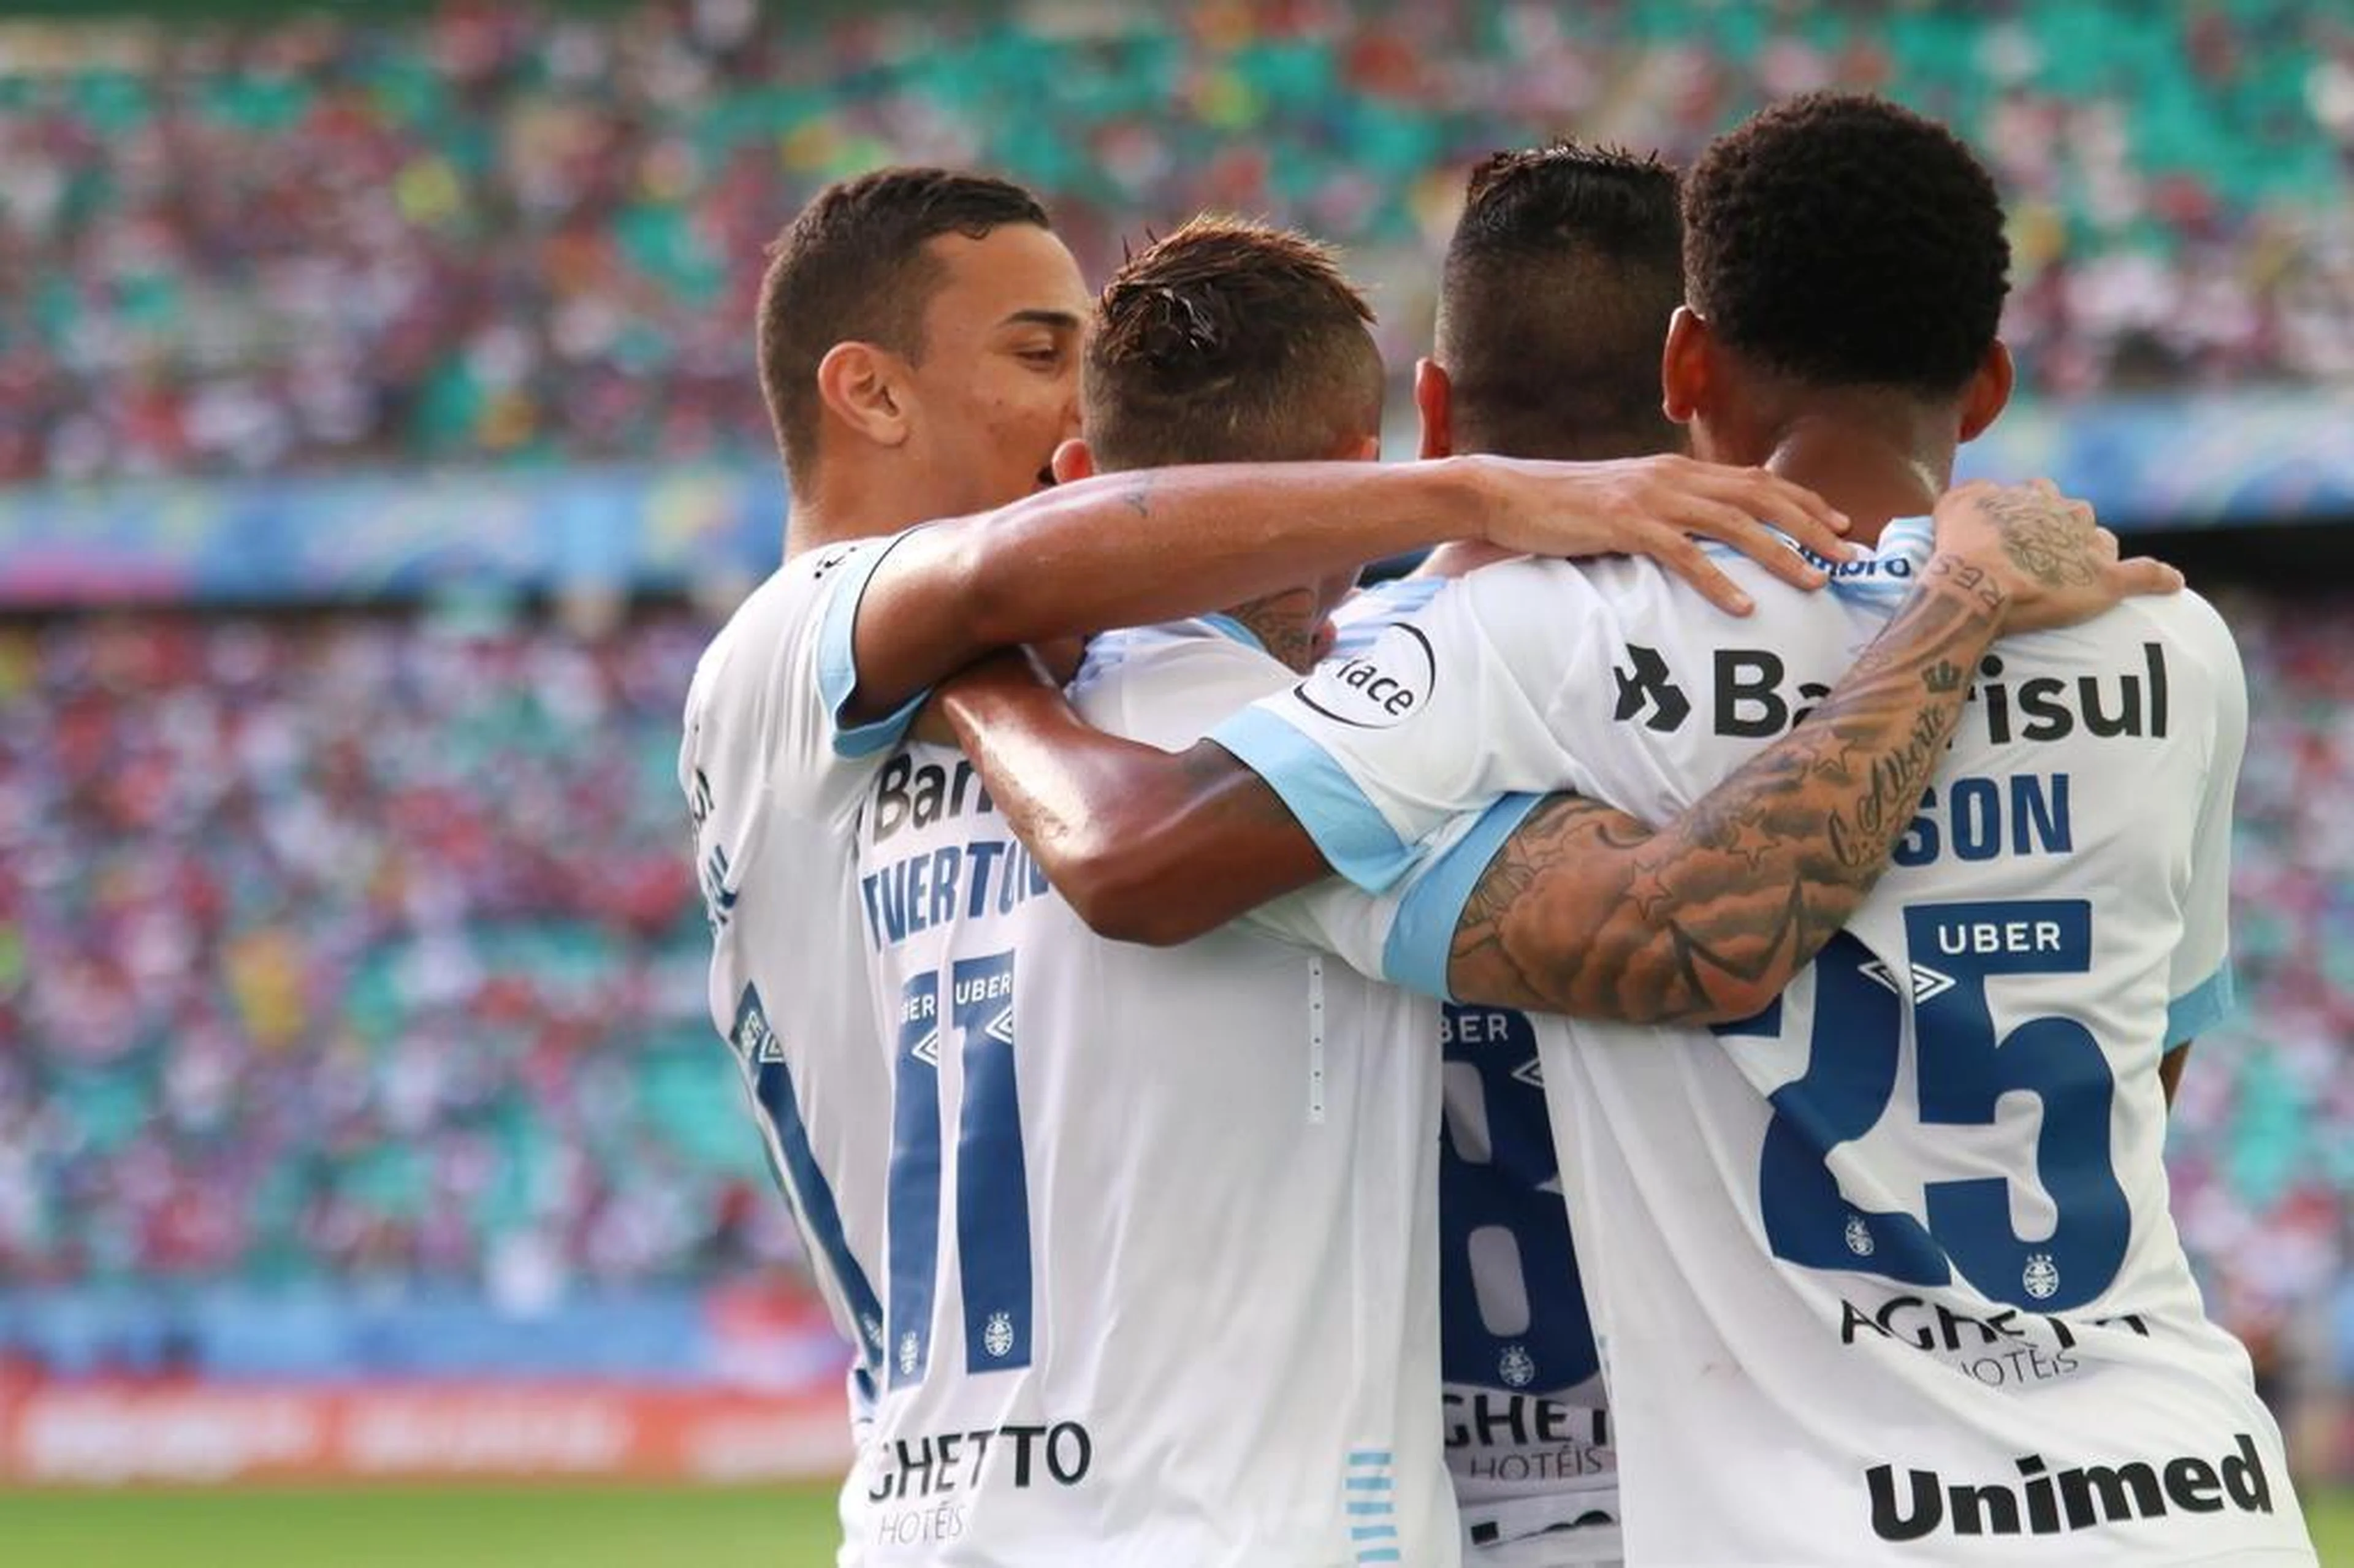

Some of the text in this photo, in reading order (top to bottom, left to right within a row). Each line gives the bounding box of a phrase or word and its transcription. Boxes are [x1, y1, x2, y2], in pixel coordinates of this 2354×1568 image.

[1713, 643, 2169, 744] Bisul
[1938, 921, 2062, 955] UBER
[955, 973, 1011, 1005] UBER
[900, 994, 935, 1024] ER
[1441, 1014, 1509, 1043] BER
[1709, 899, 2131, 1313] 25
[1469, 1444, 1603, 1480] HOTÉIS
[1866, 1433, 2274, 1542] Unimed
[878, 1502, 965, 1545] HOTÉIS
